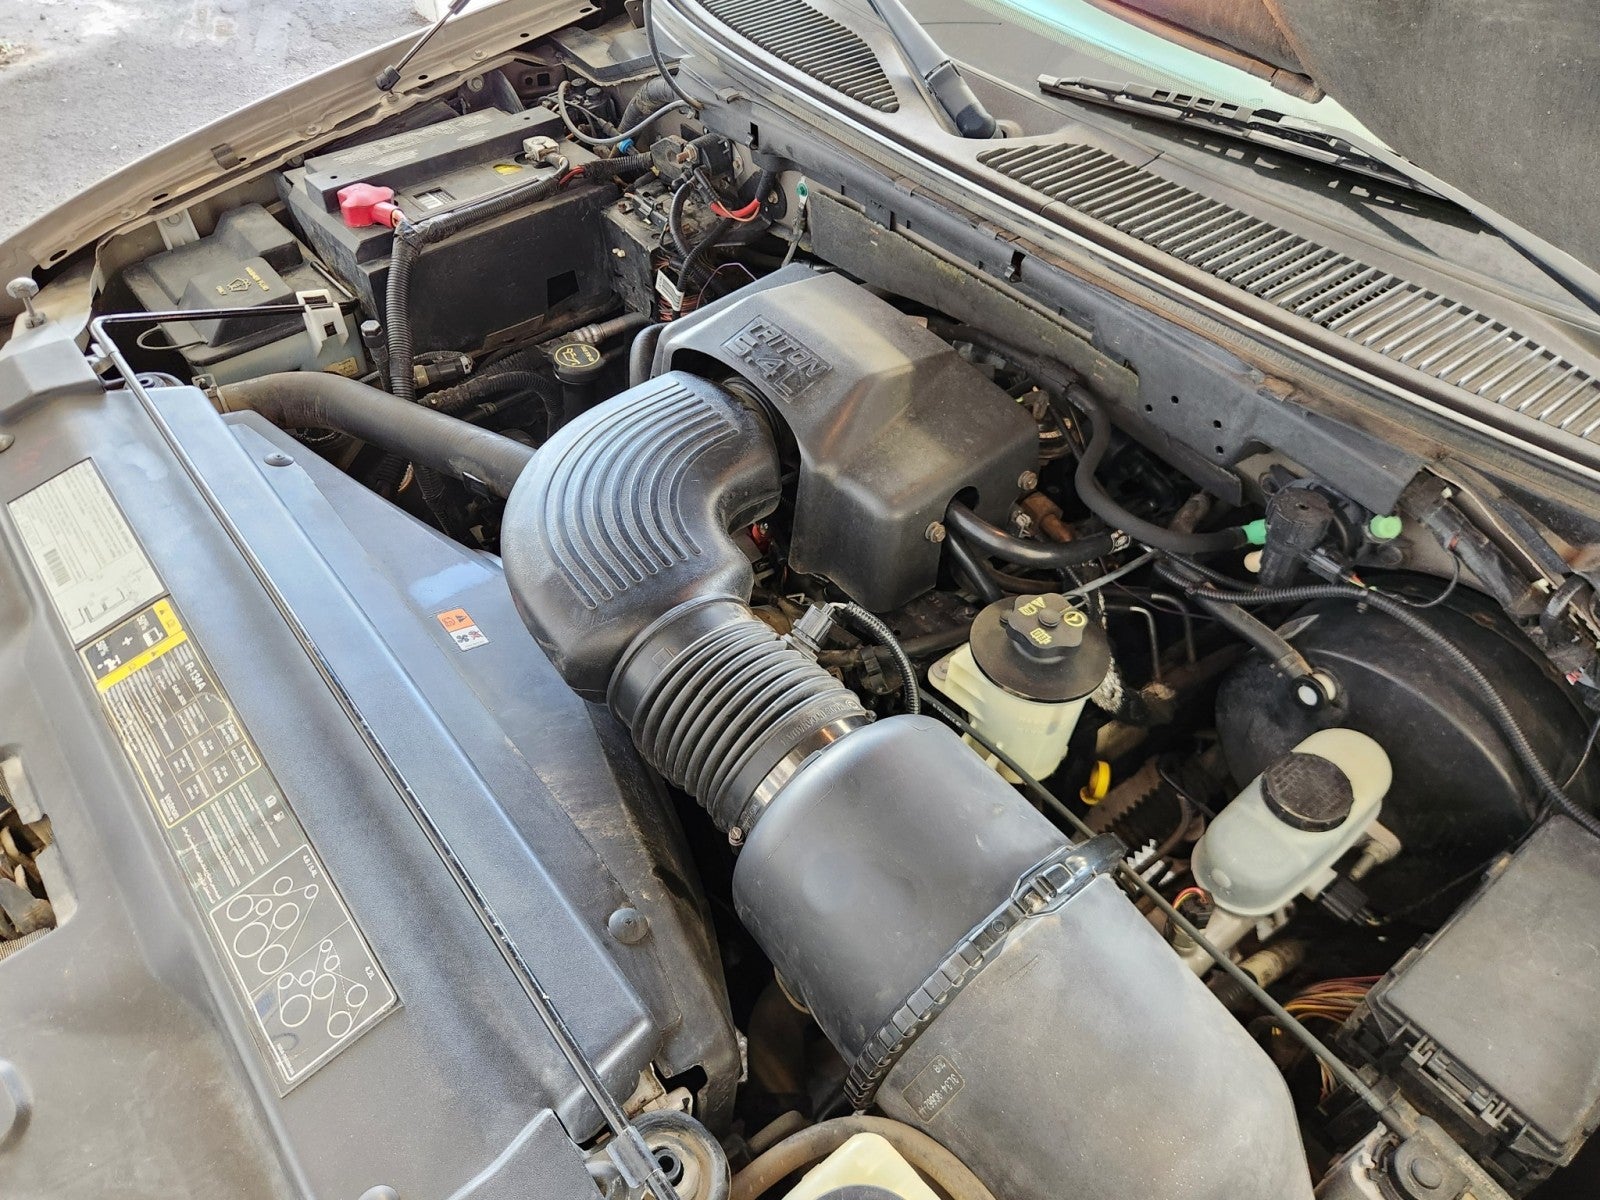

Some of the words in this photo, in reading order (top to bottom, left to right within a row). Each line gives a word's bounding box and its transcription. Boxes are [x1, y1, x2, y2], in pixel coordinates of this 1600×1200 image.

[749, 323, 827, 379] TRITON
[183, 660, 207, 692] R-134A
[363, 964, 375, 981] 4.2L
